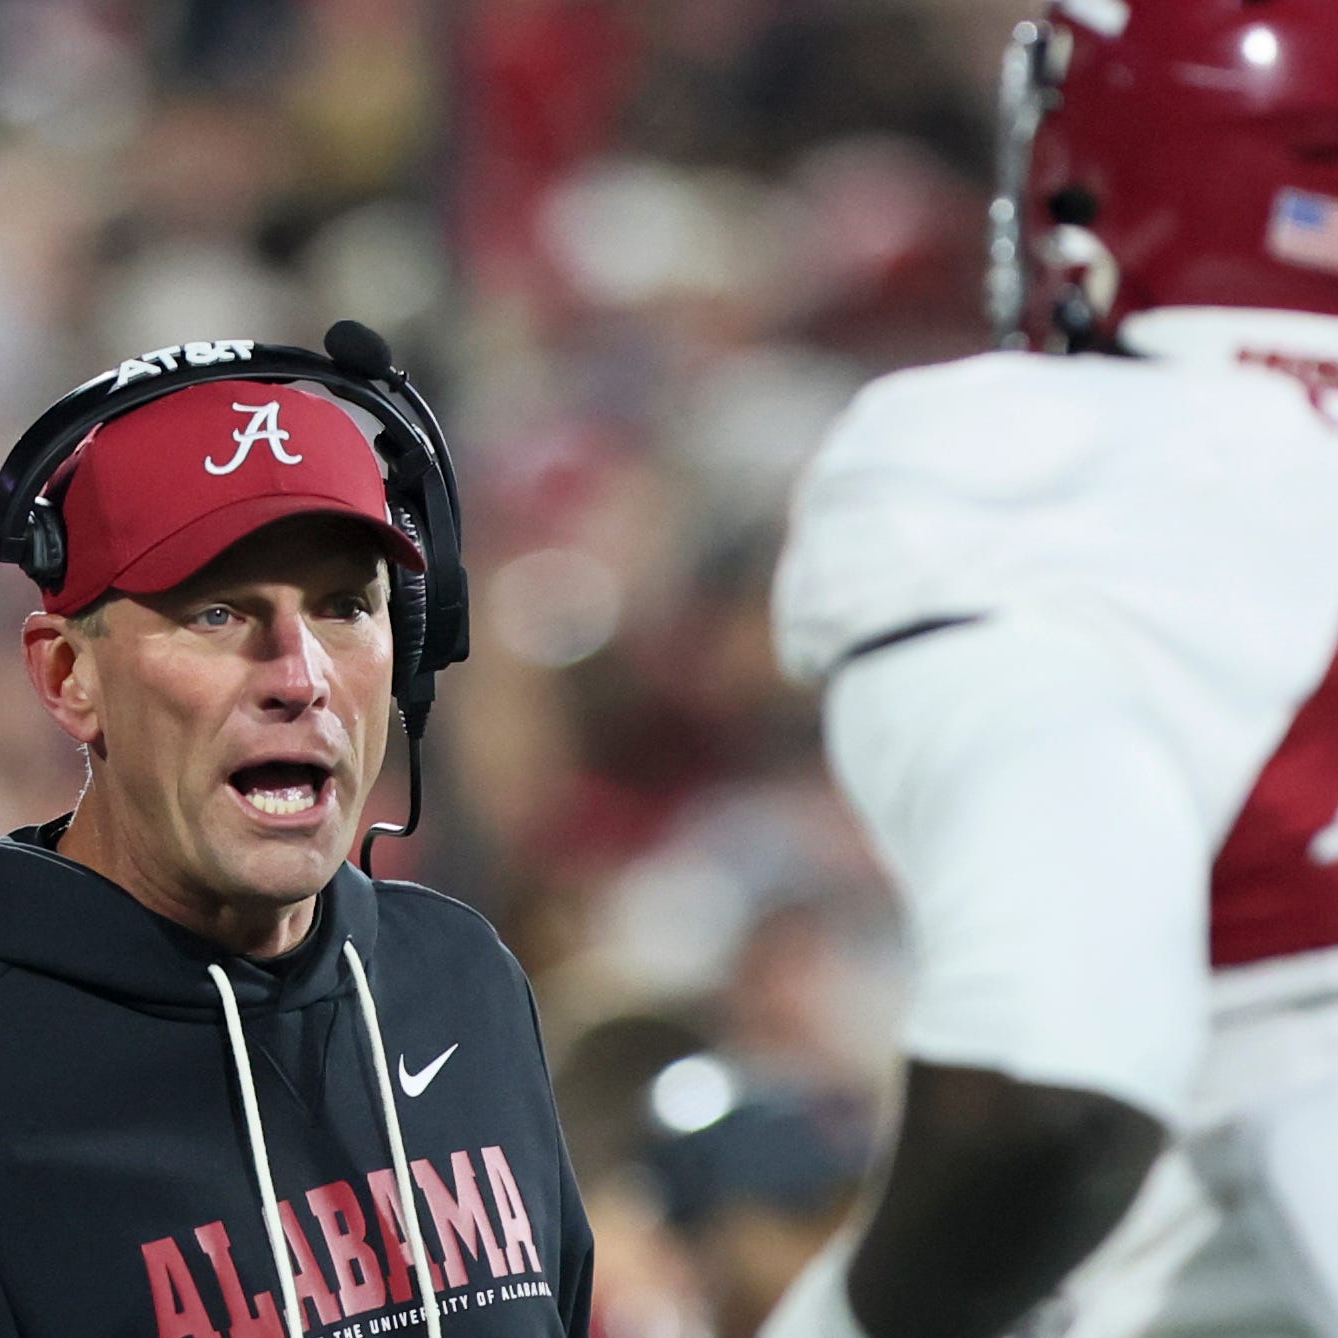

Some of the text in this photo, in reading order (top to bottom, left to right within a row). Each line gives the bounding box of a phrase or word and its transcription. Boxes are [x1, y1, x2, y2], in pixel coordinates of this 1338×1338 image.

[110, 339, 255, 388] AT&T
[204, 400, 303, 476] A
[369, 1295, 469, 1335] UNIVERITY
[476, 1288, 495, 1307] OF
